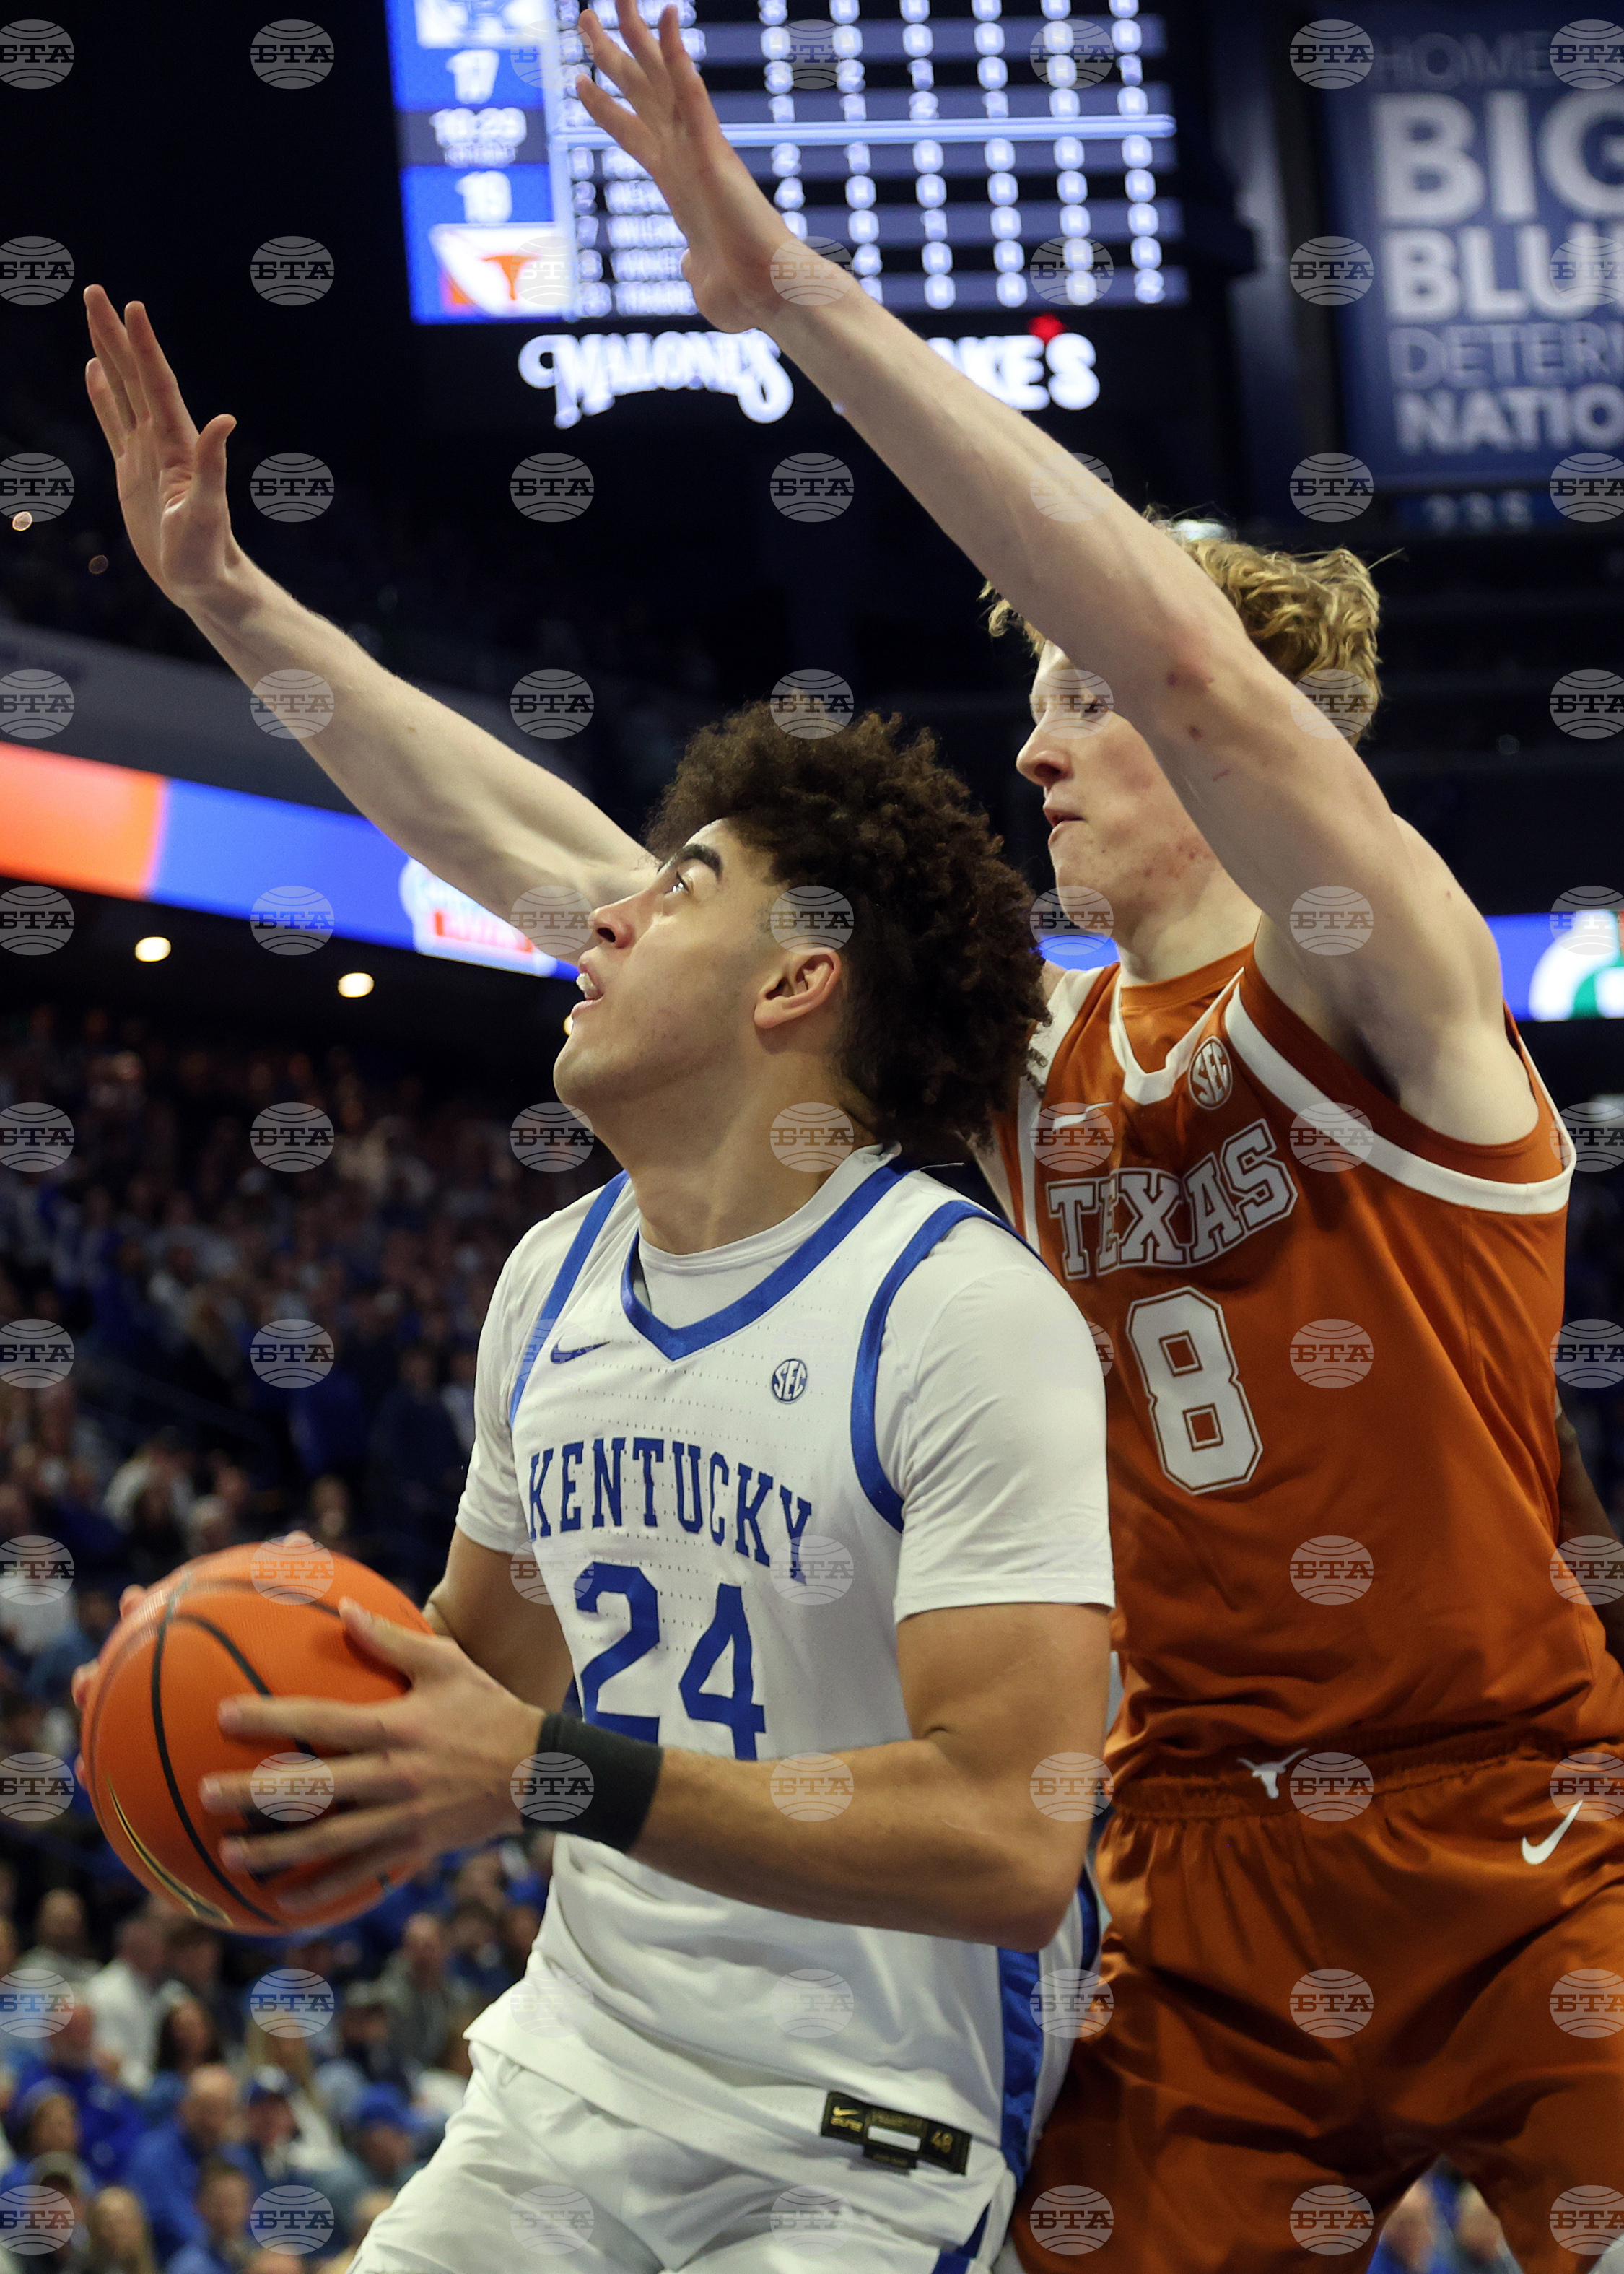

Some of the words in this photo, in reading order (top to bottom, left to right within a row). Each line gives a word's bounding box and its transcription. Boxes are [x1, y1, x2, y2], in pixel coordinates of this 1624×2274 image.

[1381, 224, 1624, 322] BLU
[1045, 1118, 1298, 1281] TEXAS
[772, 1359, 807, 1402] SEC
[1126, 1285, 1264, 1497] 8
[529, 1437, 812, 1586] KENTUCKY
[573, 1561, 767, 1760] 24
